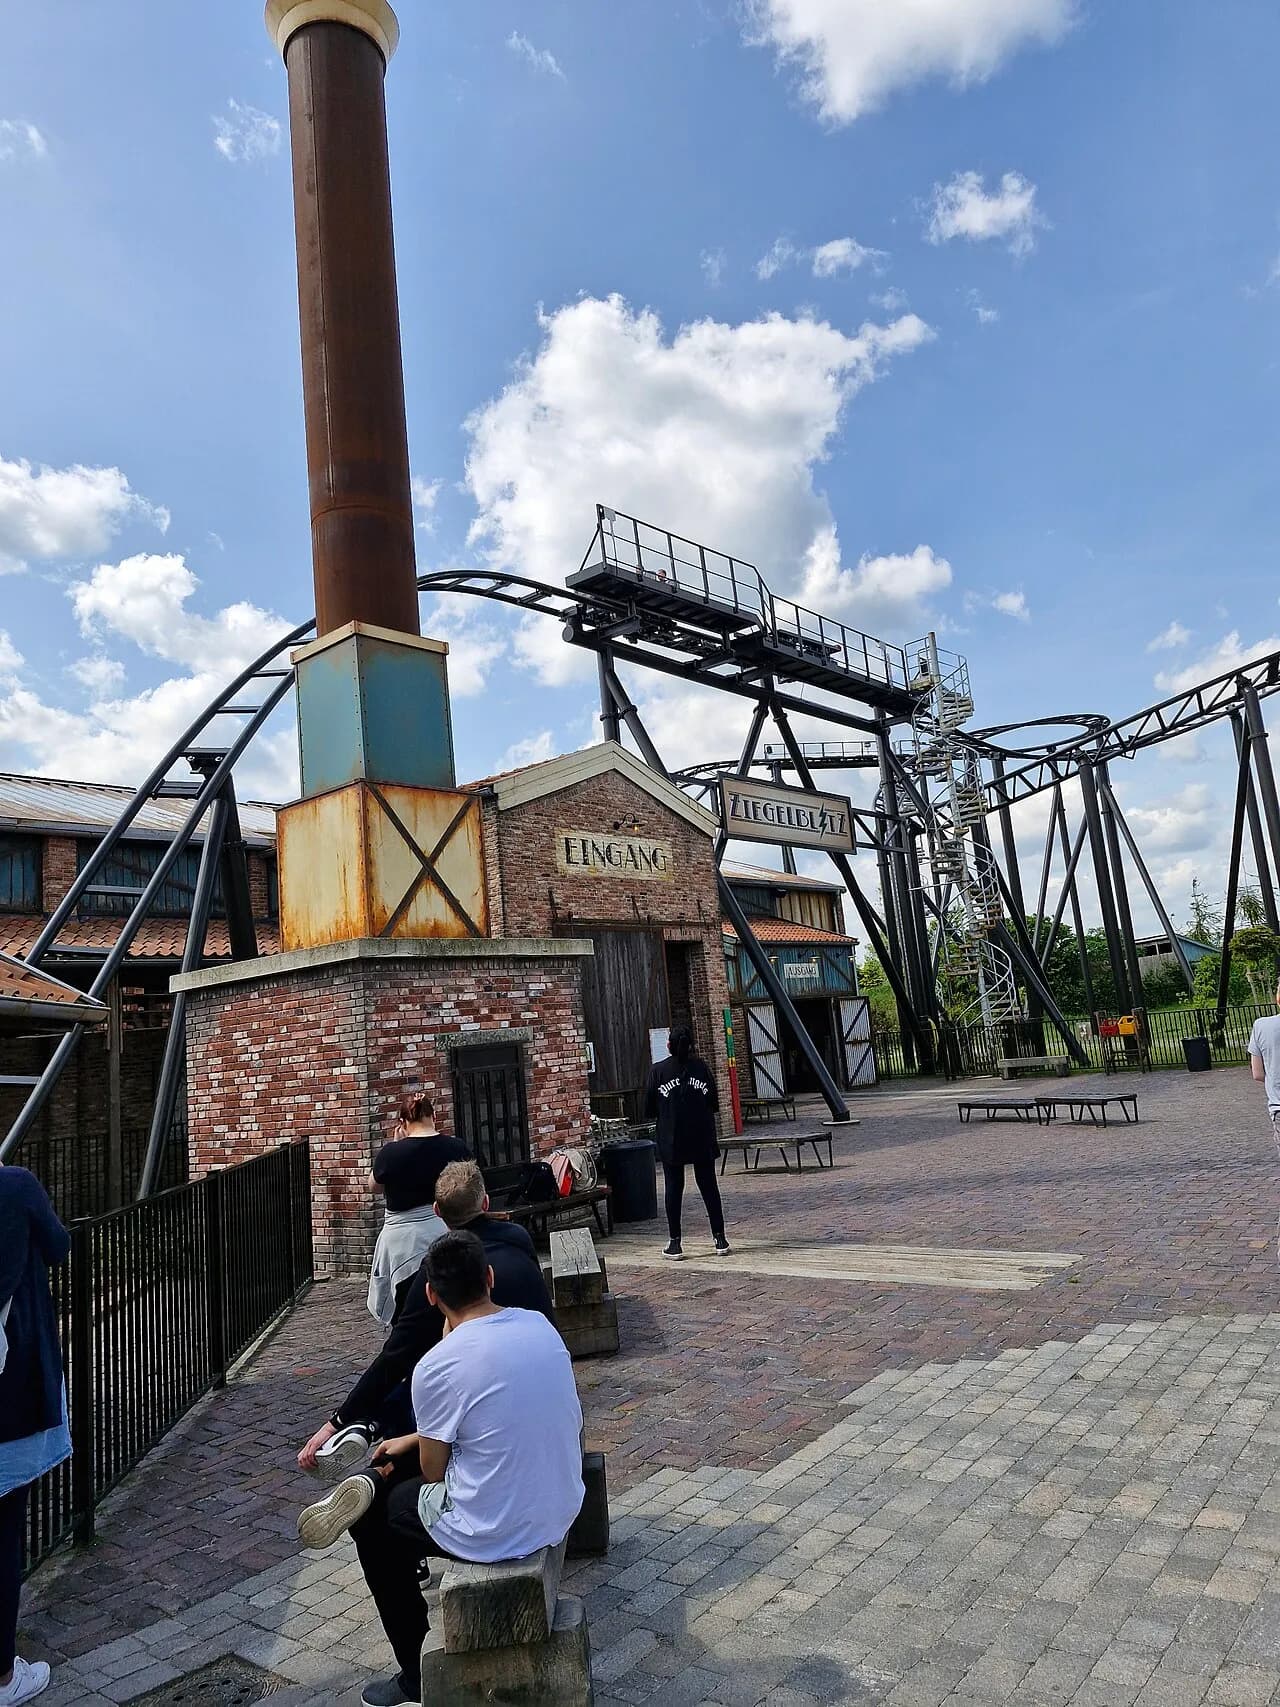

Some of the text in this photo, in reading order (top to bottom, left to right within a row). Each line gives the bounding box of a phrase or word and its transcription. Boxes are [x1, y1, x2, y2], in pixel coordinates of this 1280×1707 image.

[564, 837, 667, 872] EINGANG
[785, 965, 817, 977] AUSGANG
[657, 1077, 709, 1098] Pure ngels
